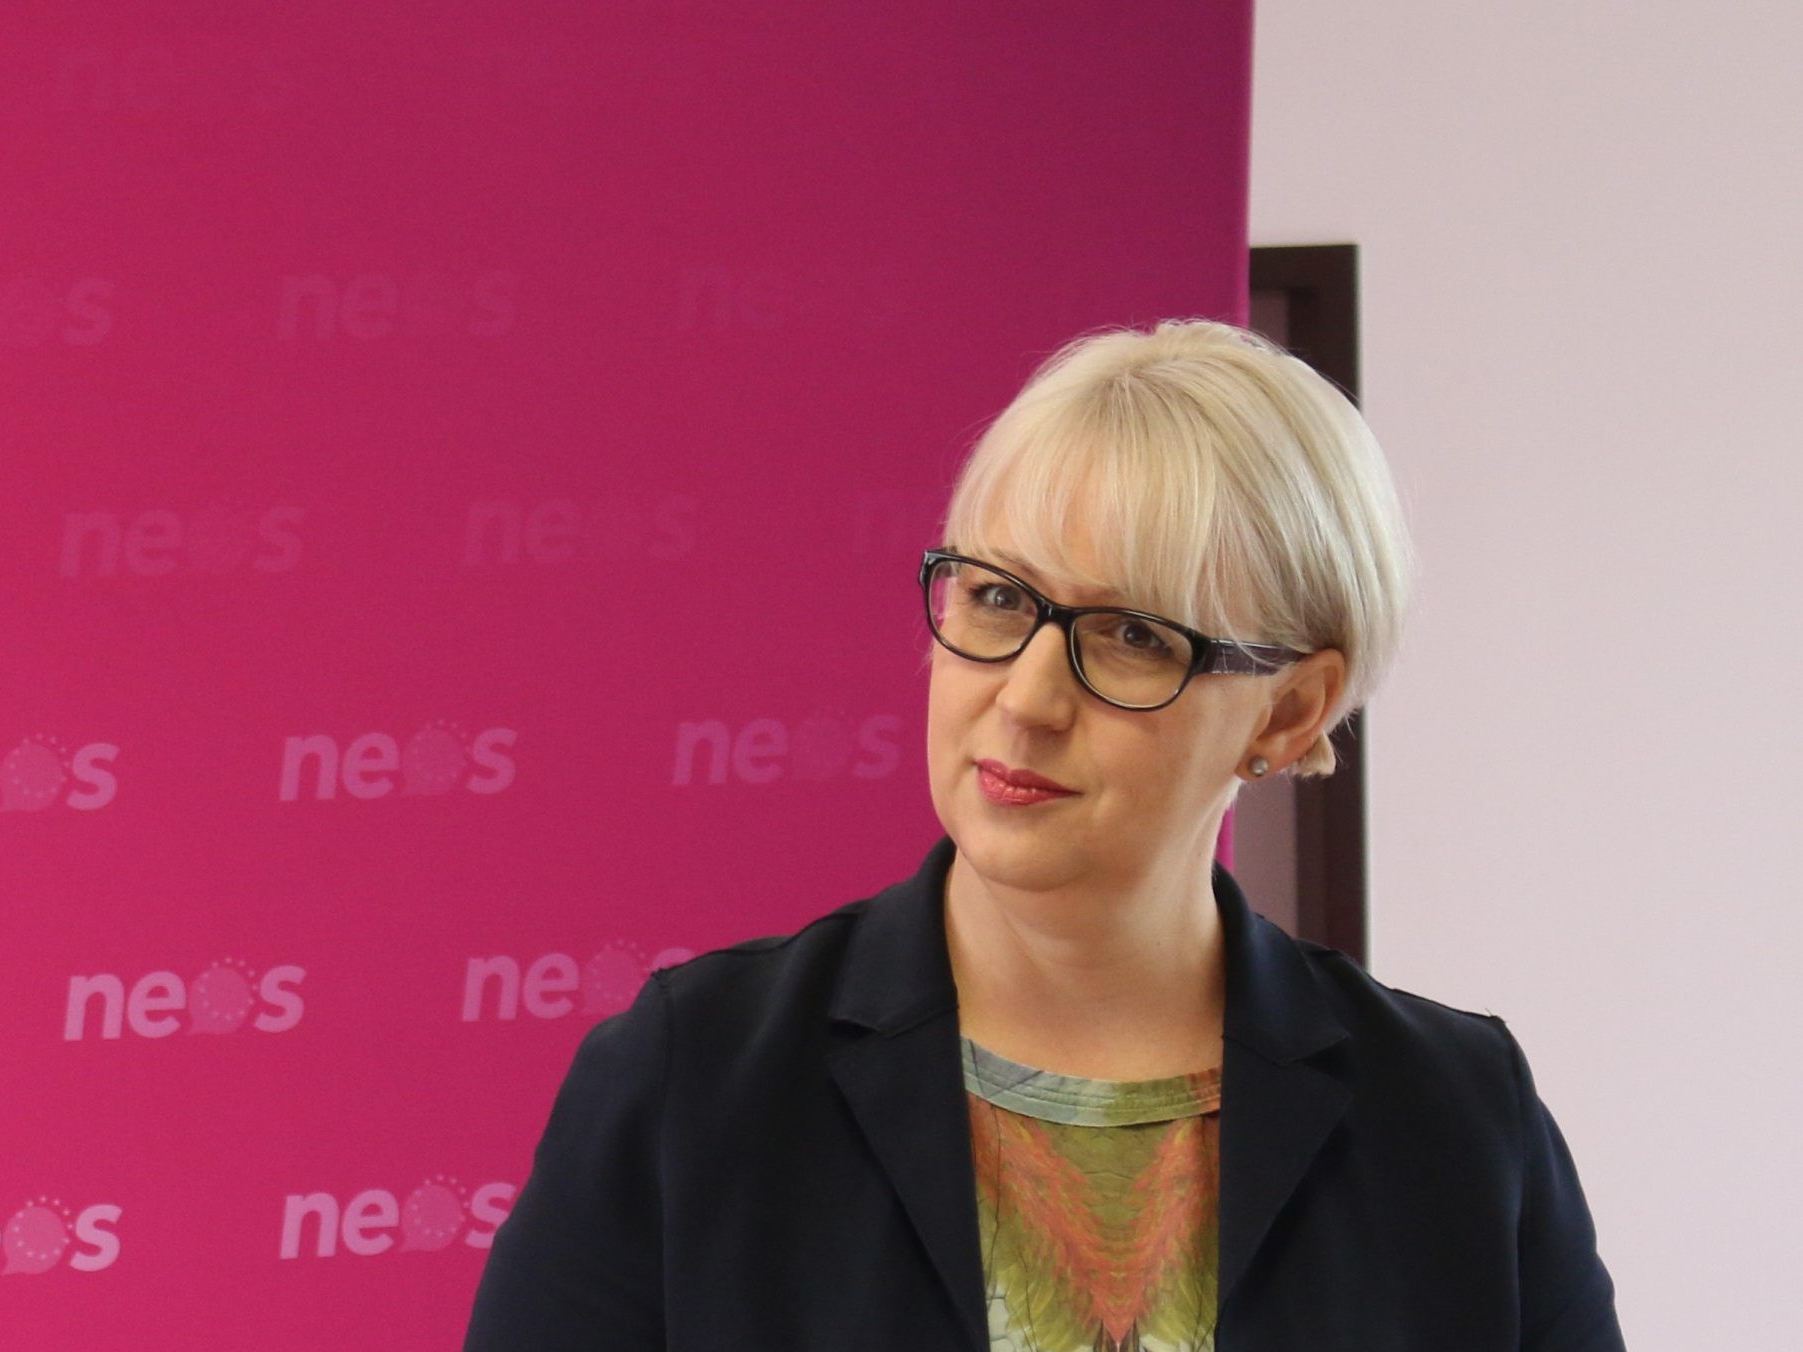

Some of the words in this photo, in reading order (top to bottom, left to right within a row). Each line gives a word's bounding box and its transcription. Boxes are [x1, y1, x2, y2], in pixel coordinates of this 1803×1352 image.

[277, 270, 518, 340] neos
[60, 505, 304, 577] neos
[460, 496, 696, 568] neos
[279, 728, 516, 801] neos
[673, 717, 896, 786] neos
[64, 965, 304, 1040] neos
[279, 1178, 516, 1259] neos
